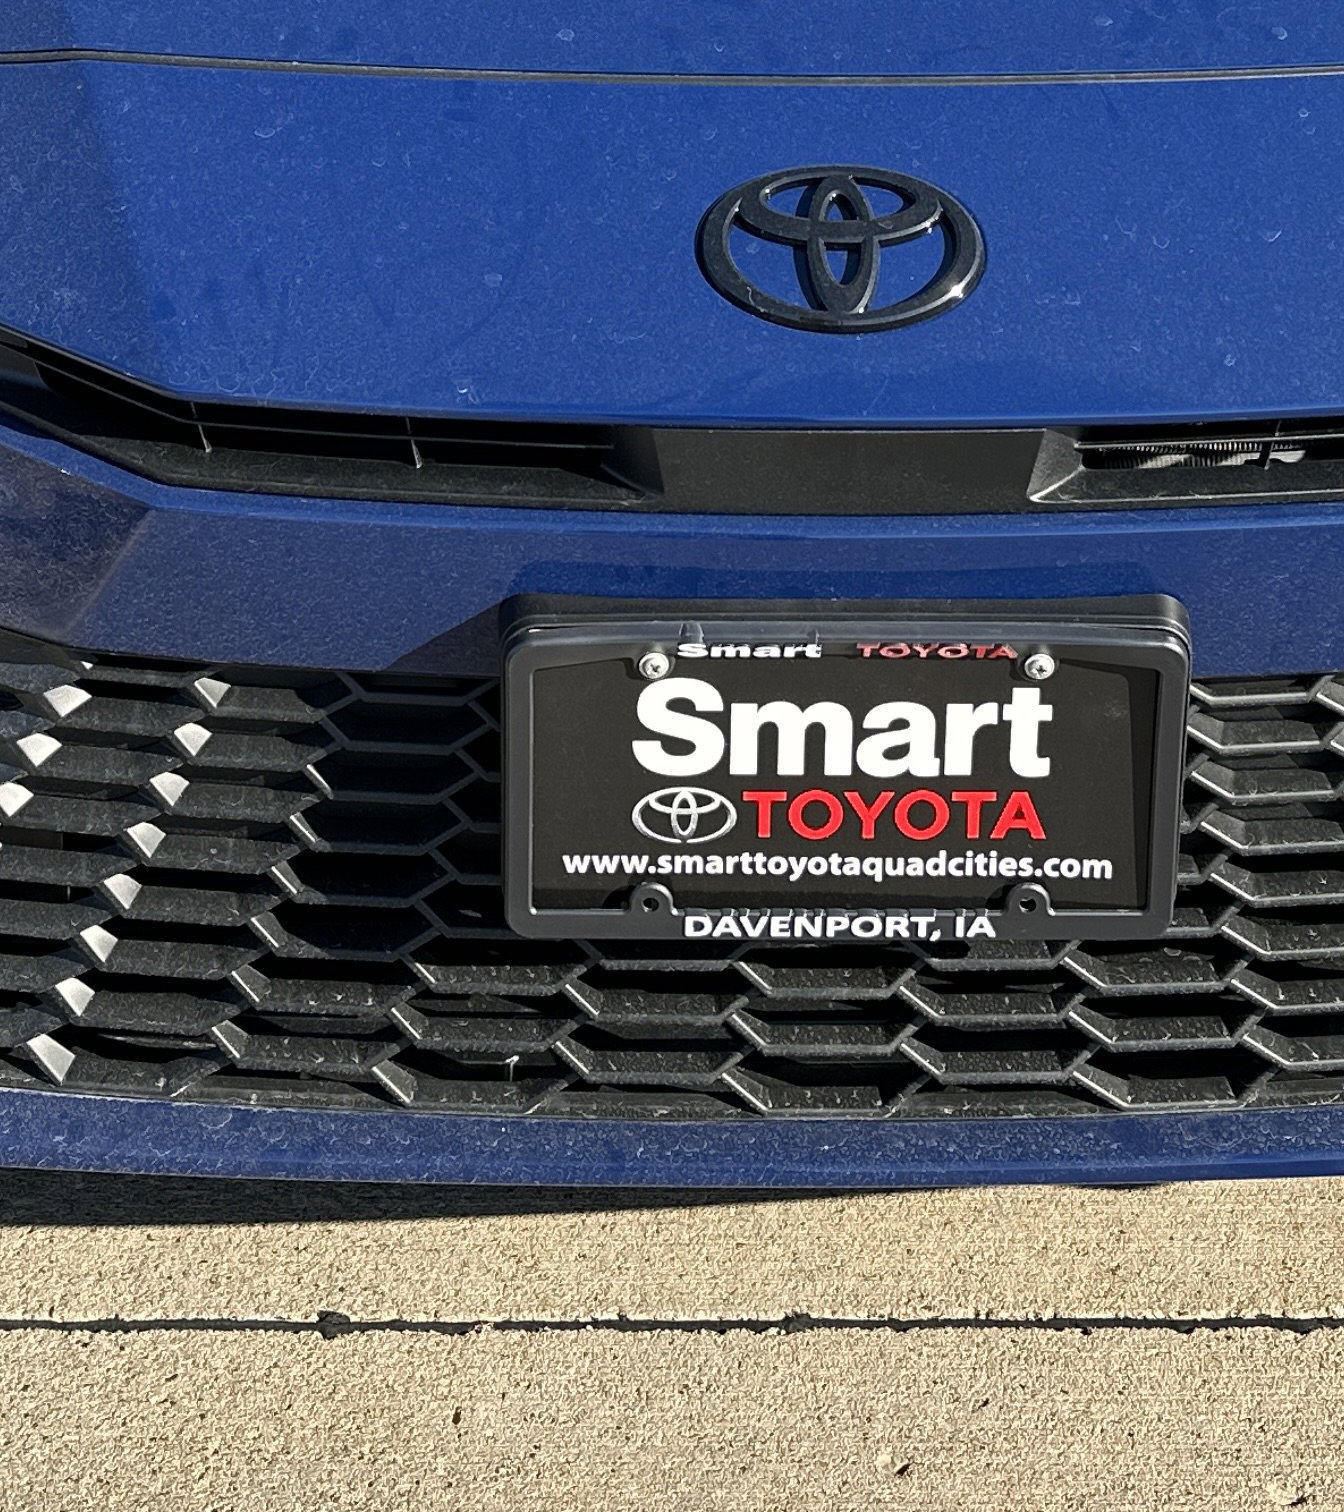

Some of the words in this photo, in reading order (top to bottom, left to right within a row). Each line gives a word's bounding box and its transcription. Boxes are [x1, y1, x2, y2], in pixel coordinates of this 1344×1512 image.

[677, 642, 822, 659] Smart
[856, 642, 1019, 659] TOYOTA
[631, 677, 1053, 779] Smart
[742, 789, 1047, 841] TOYOTA
[562, 850, 1114, 883] www.smarttoyotaquadcities.com
[683, 915, 941, 942] DAVENPORT,
[955, 915, 996, 939] IA
